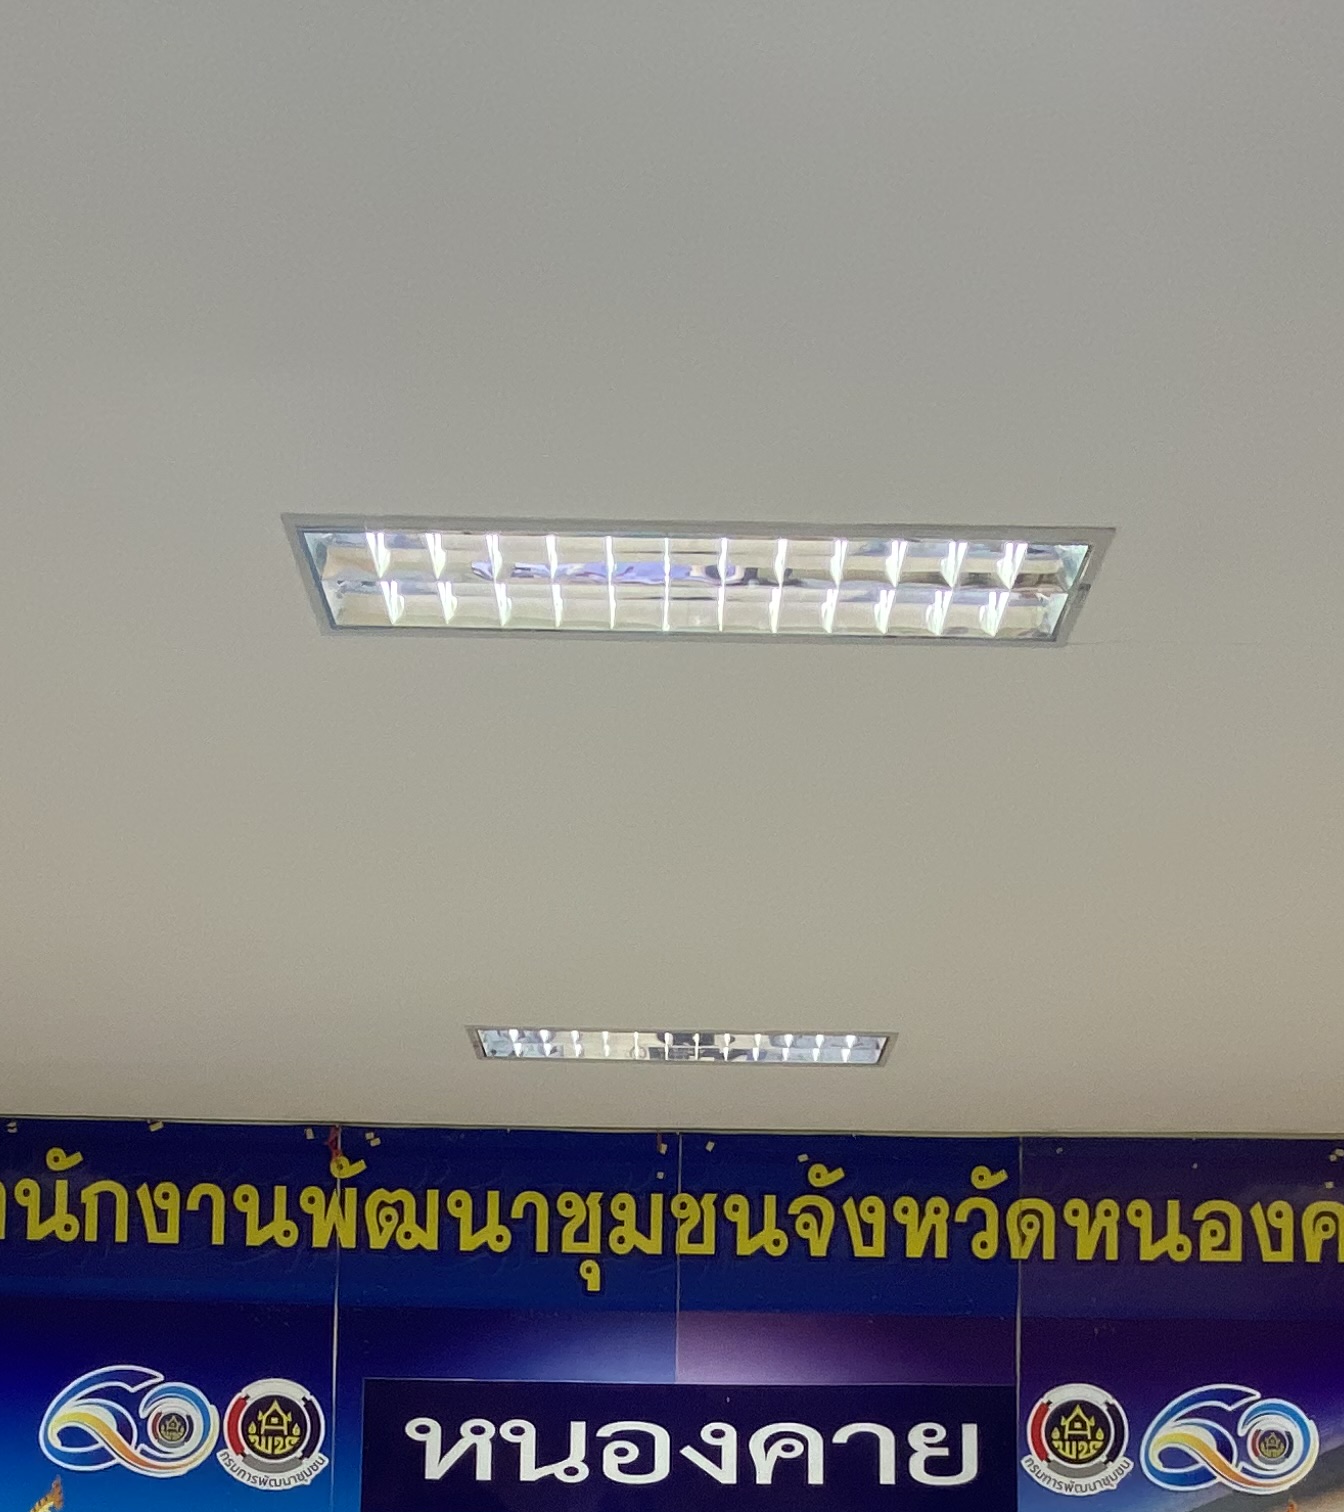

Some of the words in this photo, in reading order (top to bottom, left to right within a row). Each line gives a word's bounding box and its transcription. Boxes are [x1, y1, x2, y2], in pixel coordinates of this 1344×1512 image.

[219, 1450, 327, 1488] กรมการพัฒนาชุมชน
[405, 1417, 978, 1484] หนองคาย
[1023, 1457, 1131, 1494] กรมการพัฒนาชุมชน
